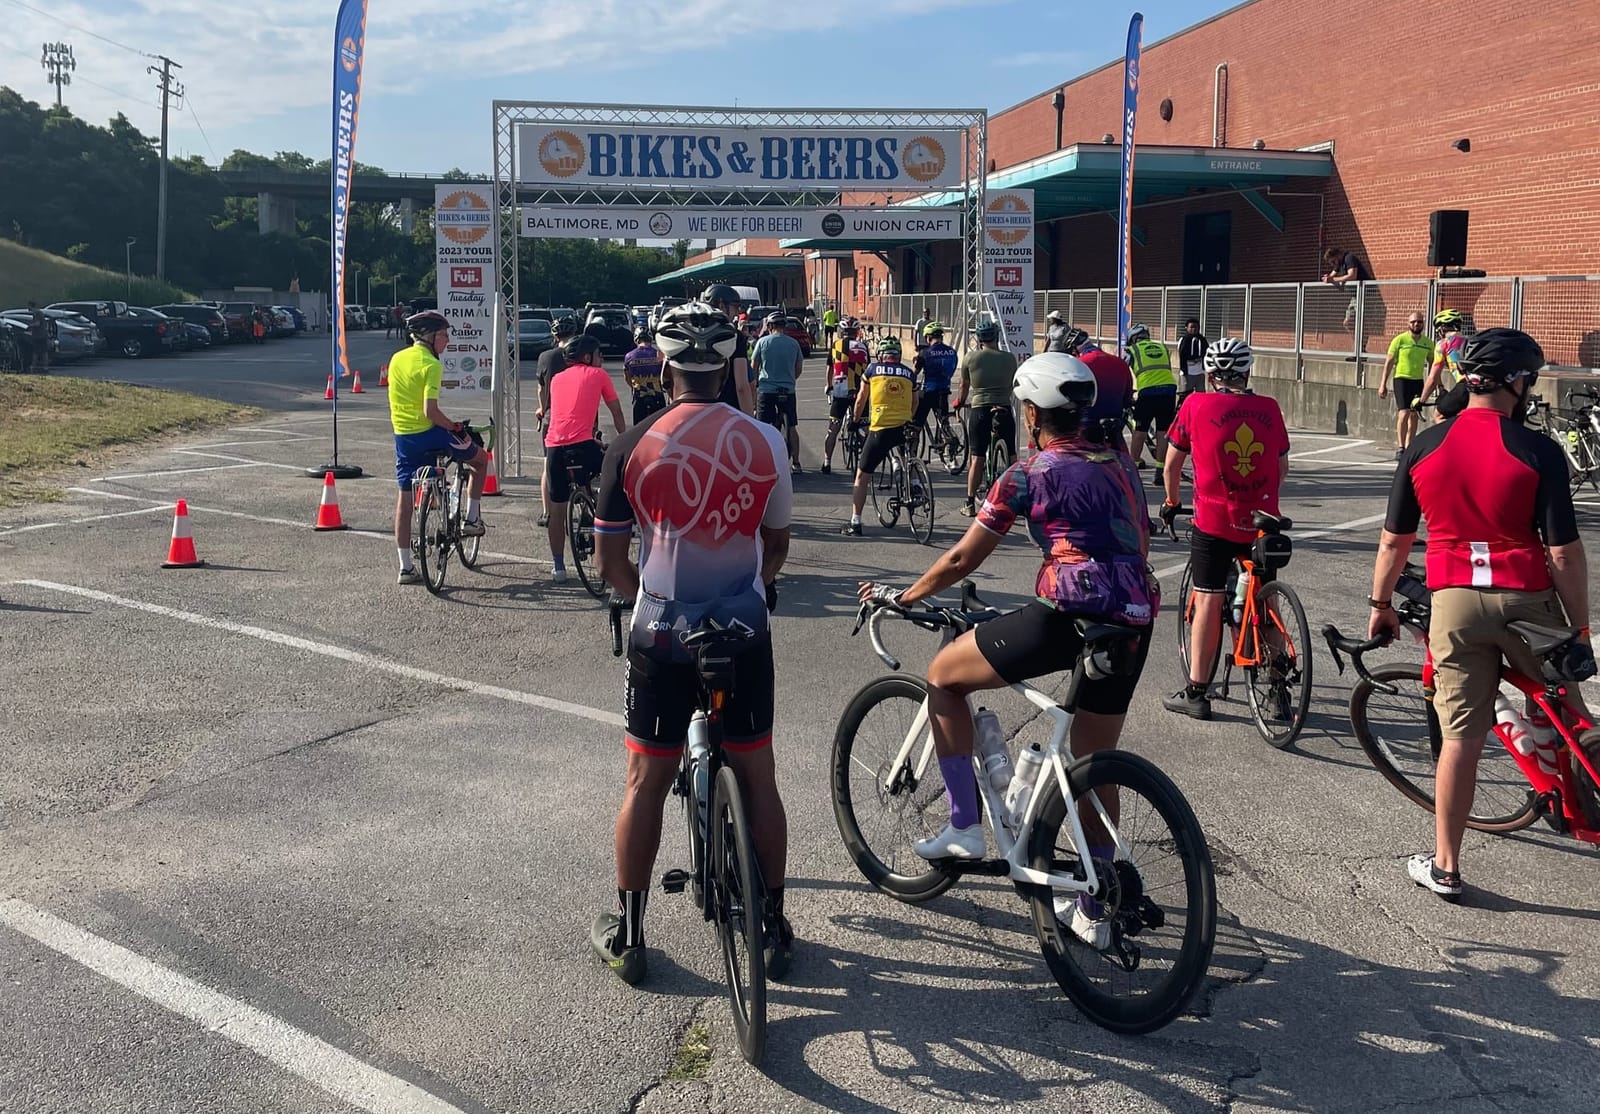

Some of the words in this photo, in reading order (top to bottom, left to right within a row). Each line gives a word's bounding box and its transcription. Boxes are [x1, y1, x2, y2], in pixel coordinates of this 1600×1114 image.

[1210, 160, 1262, 170] ENTRANCE
[526, 217, 612, 231] BALTIMORE,
[616, 219, 639, 231] MD
[688, 217, 707, 232] WE
[710, 217, 738, 232] BIKE
[741, 217, 765, 232] FOR
[768, 217, 802, 232] BEER!
[853, 219, 901, 232] UNION
[905, 219, 952, 232] CRAFT
[439, 247, 462, 255] 2023
[464, 247, 493, 255] TOUR
[985, 248, 1005, 256] 2023
[1006, 248, 1032, 256] TOUR
[447, 290, 486, 307] Tuesday
[444, 308, 491, 318] PRIMAL
[446, 344, 489, 352] SENA
[876, 366, 894, 375] OLD
[896, 367, 912, 378] BAY
[706, 483, 755, 540] 268
